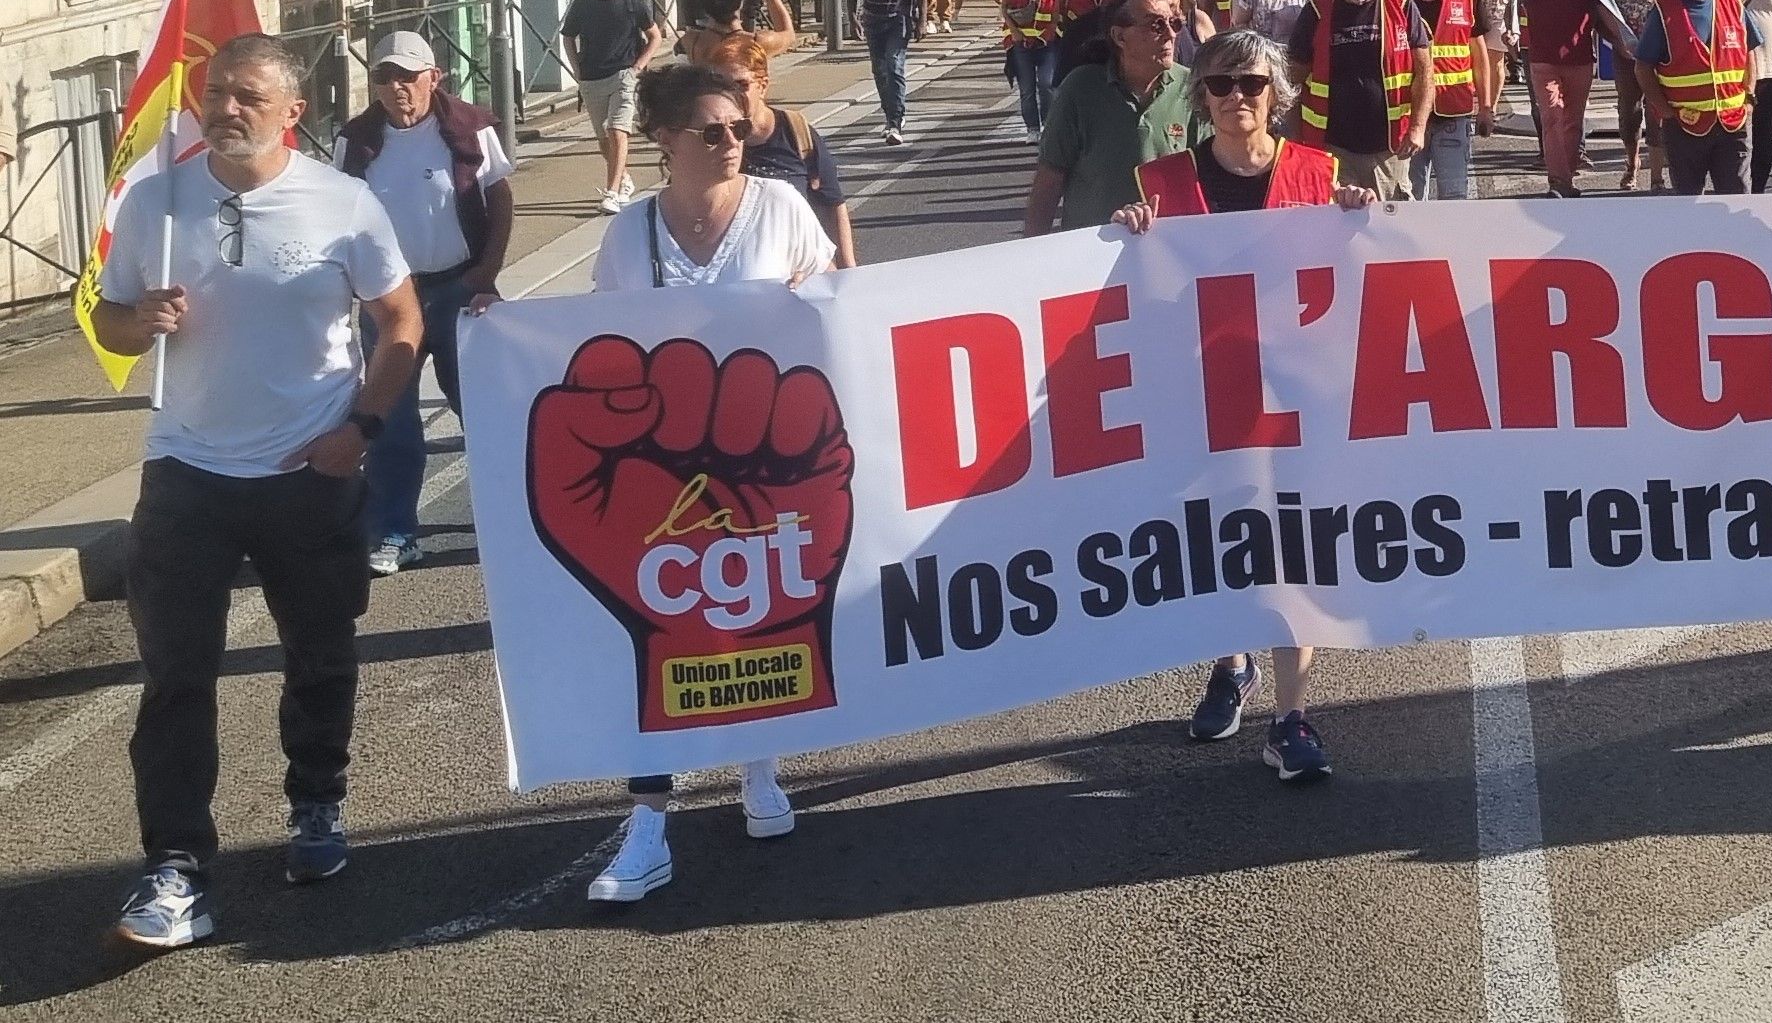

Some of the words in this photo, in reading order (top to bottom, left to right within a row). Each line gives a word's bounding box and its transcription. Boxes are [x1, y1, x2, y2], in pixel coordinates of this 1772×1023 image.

[891, 284, 1145, 510] DE
[637, 512, 816, 630] cgt
[881, 548, 1058, 667] Nos
[1078, 494, 1466, 618] salaires
[671, 658, 731, 685] Union
[735, 650, 803, 678] Locale
[679, 685, 706, 710] de
[709, 676, 799, 707] BAYONNE
